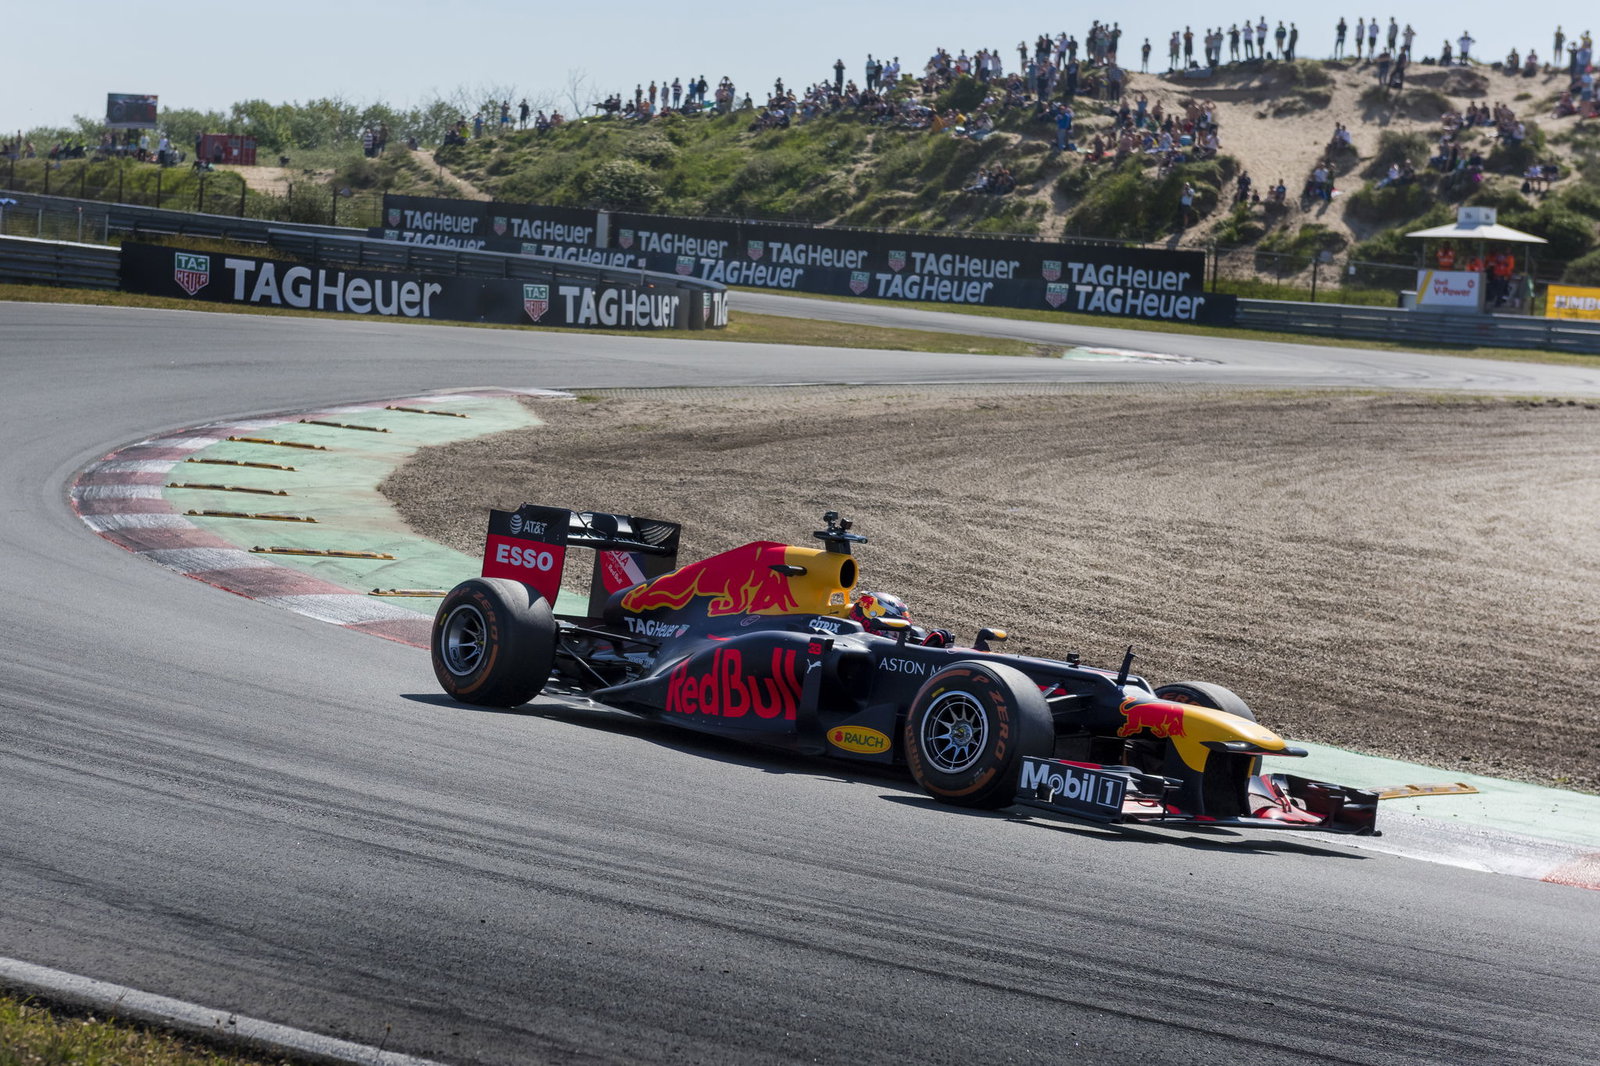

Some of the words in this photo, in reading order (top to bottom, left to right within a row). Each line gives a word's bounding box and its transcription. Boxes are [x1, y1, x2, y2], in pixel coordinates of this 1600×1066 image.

[178, 256, 206, 270] TAG
[177, 272, 207, 292] HEUER
[526, 287, 546, 299] TAG
[1434, 287, 1471, 297] V-Power
[522, 519, 548, 535] AT&T
[496, 543, 553, 572] ESSO
[879, 657, 926, 676] ASTON
[988, 690, 1009, 760] ZERO
[844, 732, 884, 748] RAUCH
[1021, 761, 1096, 803] Mobil
